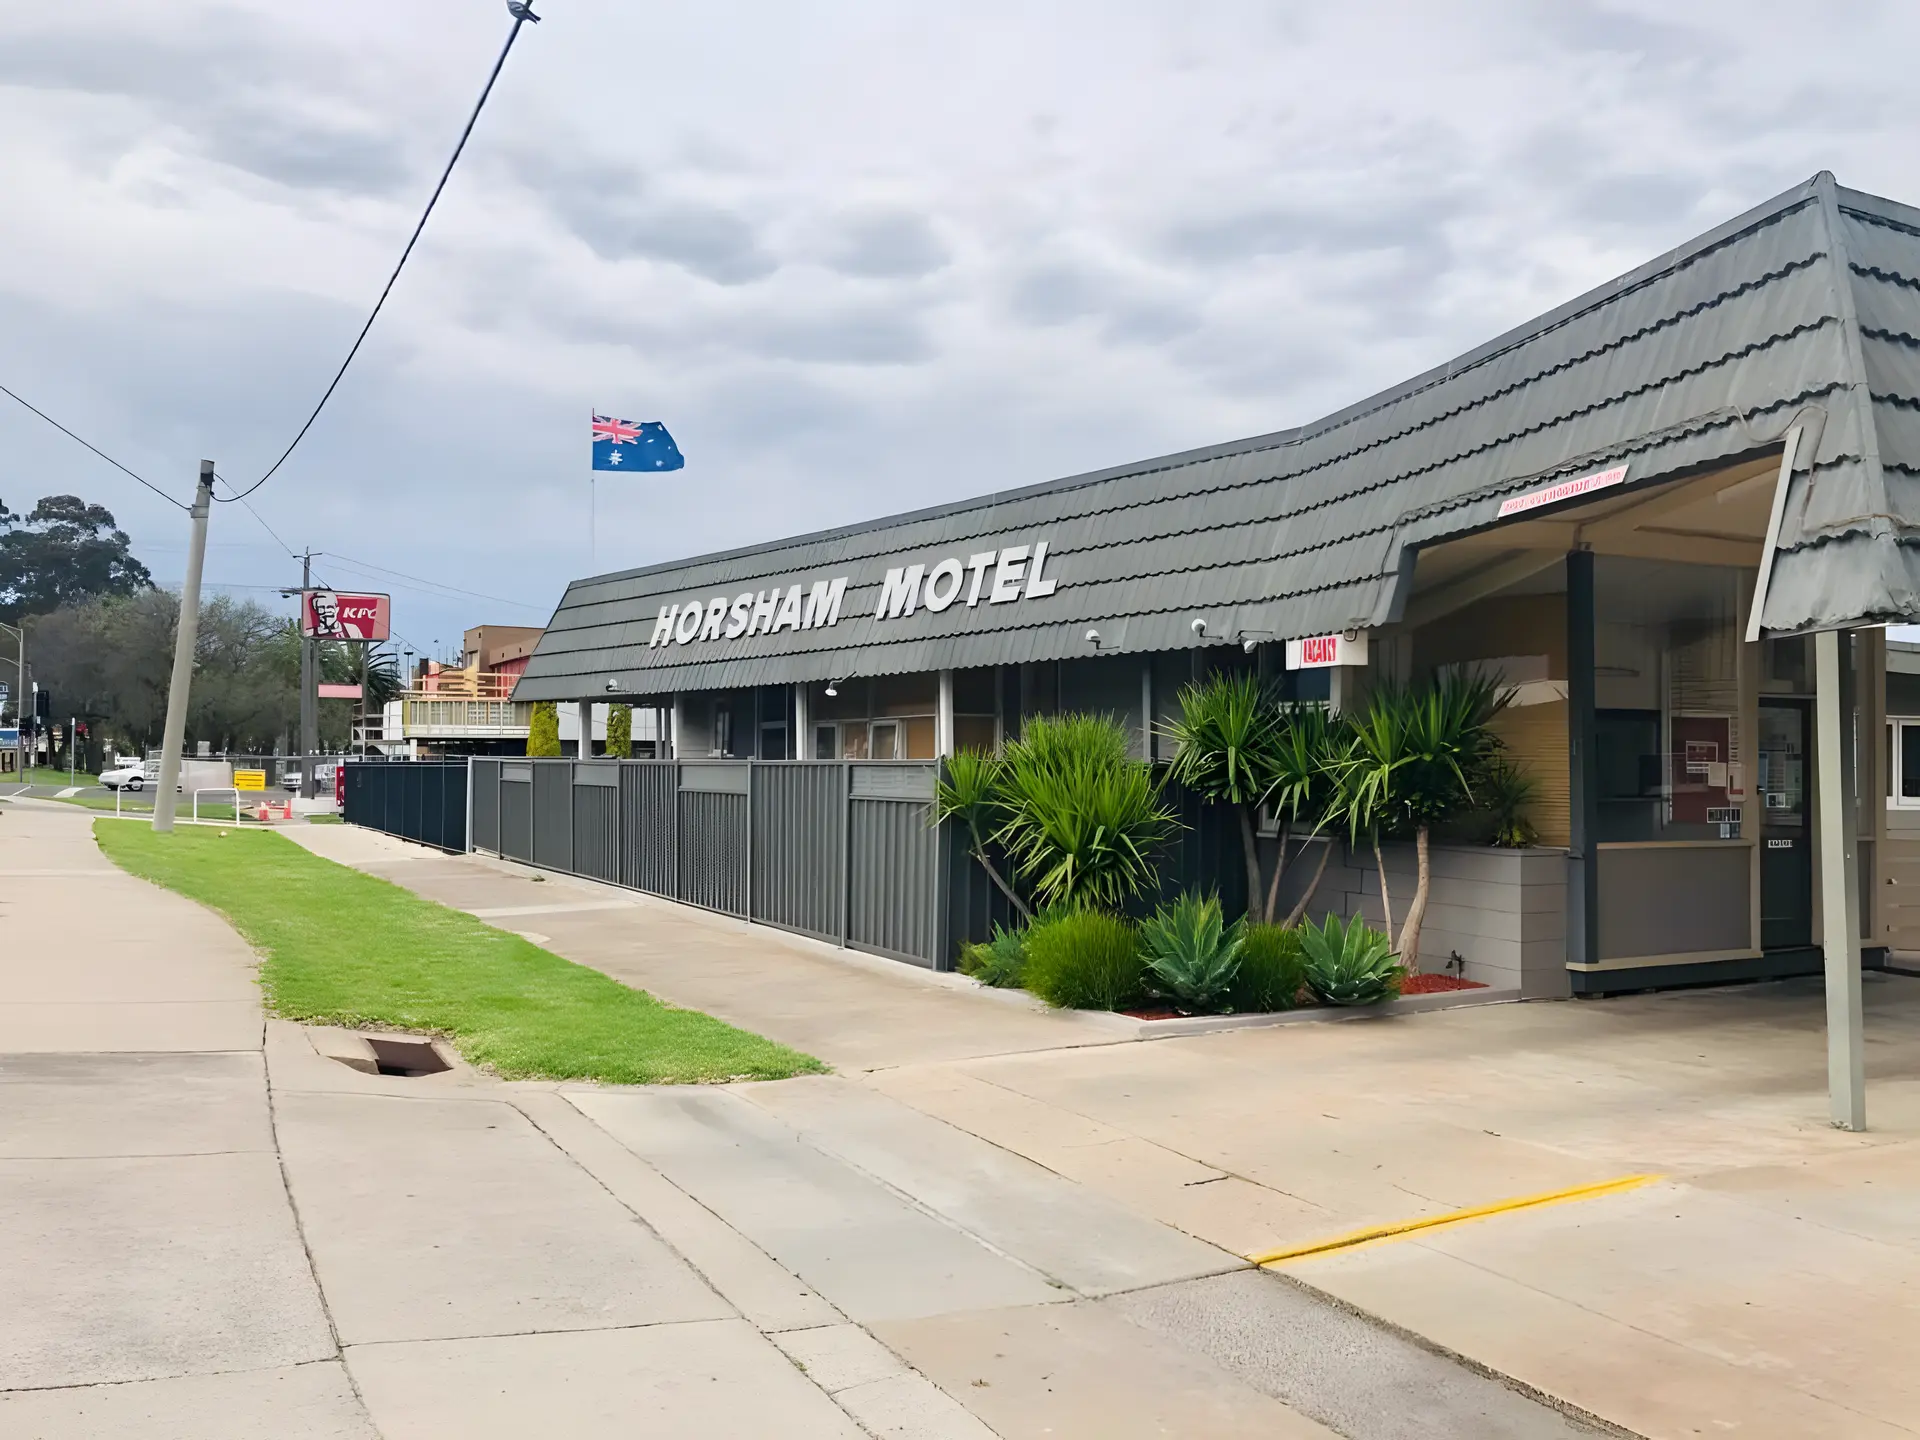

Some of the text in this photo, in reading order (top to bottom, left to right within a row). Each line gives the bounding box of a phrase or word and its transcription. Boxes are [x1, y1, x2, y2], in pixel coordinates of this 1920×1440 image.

[342, 607, 377, 619] KFC
[650, 541, 1059, 649] HORSHAM MOTEL
